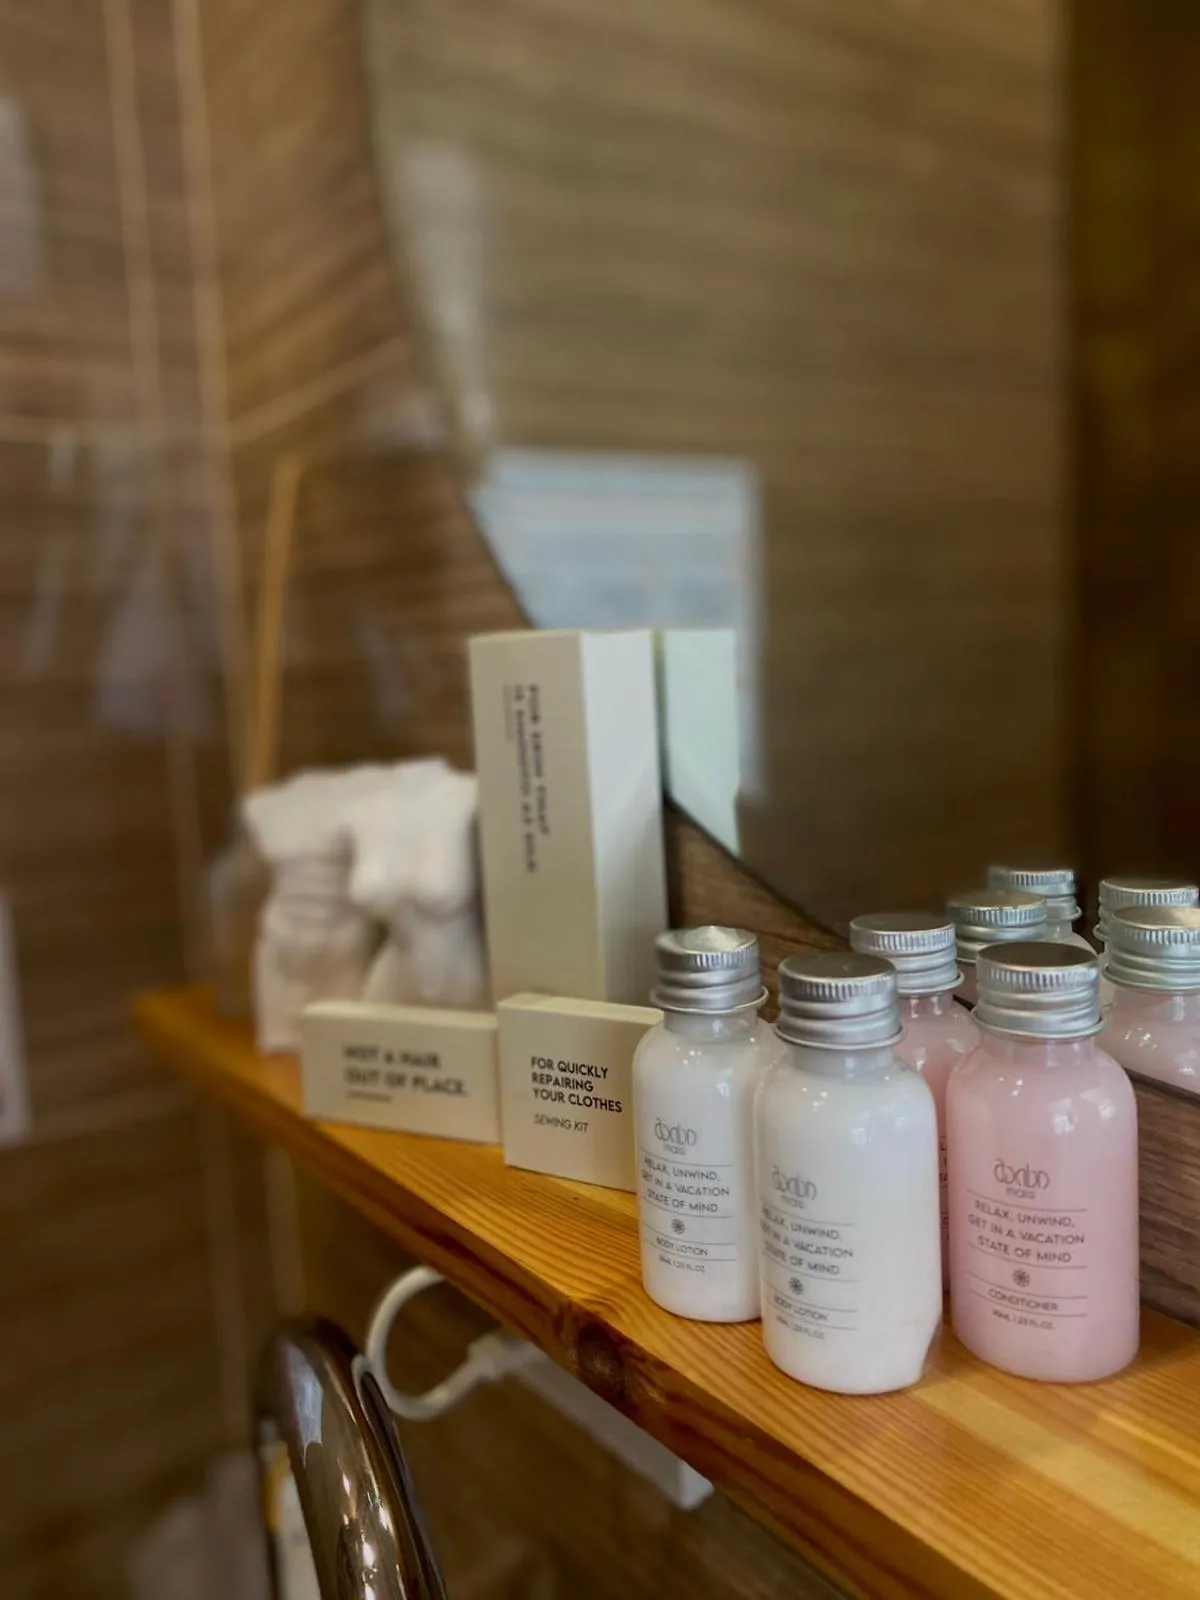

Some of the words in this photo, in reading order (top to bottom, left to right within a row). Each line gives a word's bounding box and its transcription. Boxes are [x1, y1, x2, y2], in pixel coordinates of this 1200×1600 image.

[531, 1056, 555, 1072] FOR
[557, 1060, 608, 1080] QUICKLY
[531, 1072, 594, 1092] REPAIRING
[532, 1087, 566, 1105] YOUR
[568, 1093, 622, 1113] CLOTHES
[534, 1113, 572, 1131] SEWING
[574, 1120, 589, 1133] KIT
[654, 1177, 663, 1187] IN
[665, 1181, 672, 1190] A
[675, 1183, 730, 1197] VACATION
[647, 1188, 669, 1205] STATE
[671, 1199, 685, 1209] OF
[688, 1203, 718, 1213] MIND
[967, 1213, 987, 1229] GET
[991, 1223, 1003, 1235] IN
[1006, 1229, 1015, 1239] A
[1019, 1231, 1085, 1245] VACATION
[783, 1236, 790, 1246] A
[792, 1239, 854, 1259] VACATION
[978, 1235, 1011, 1255] STATE
[1014, 1247, 1032, 1258] OF
[1037, 1251, 1072, 1263] MIND
[789, 1256, 804, 1267] OF
[807, 1262, 840, 1275] MIND
[988, 1288, 1059, 1311] CONDITIONER
